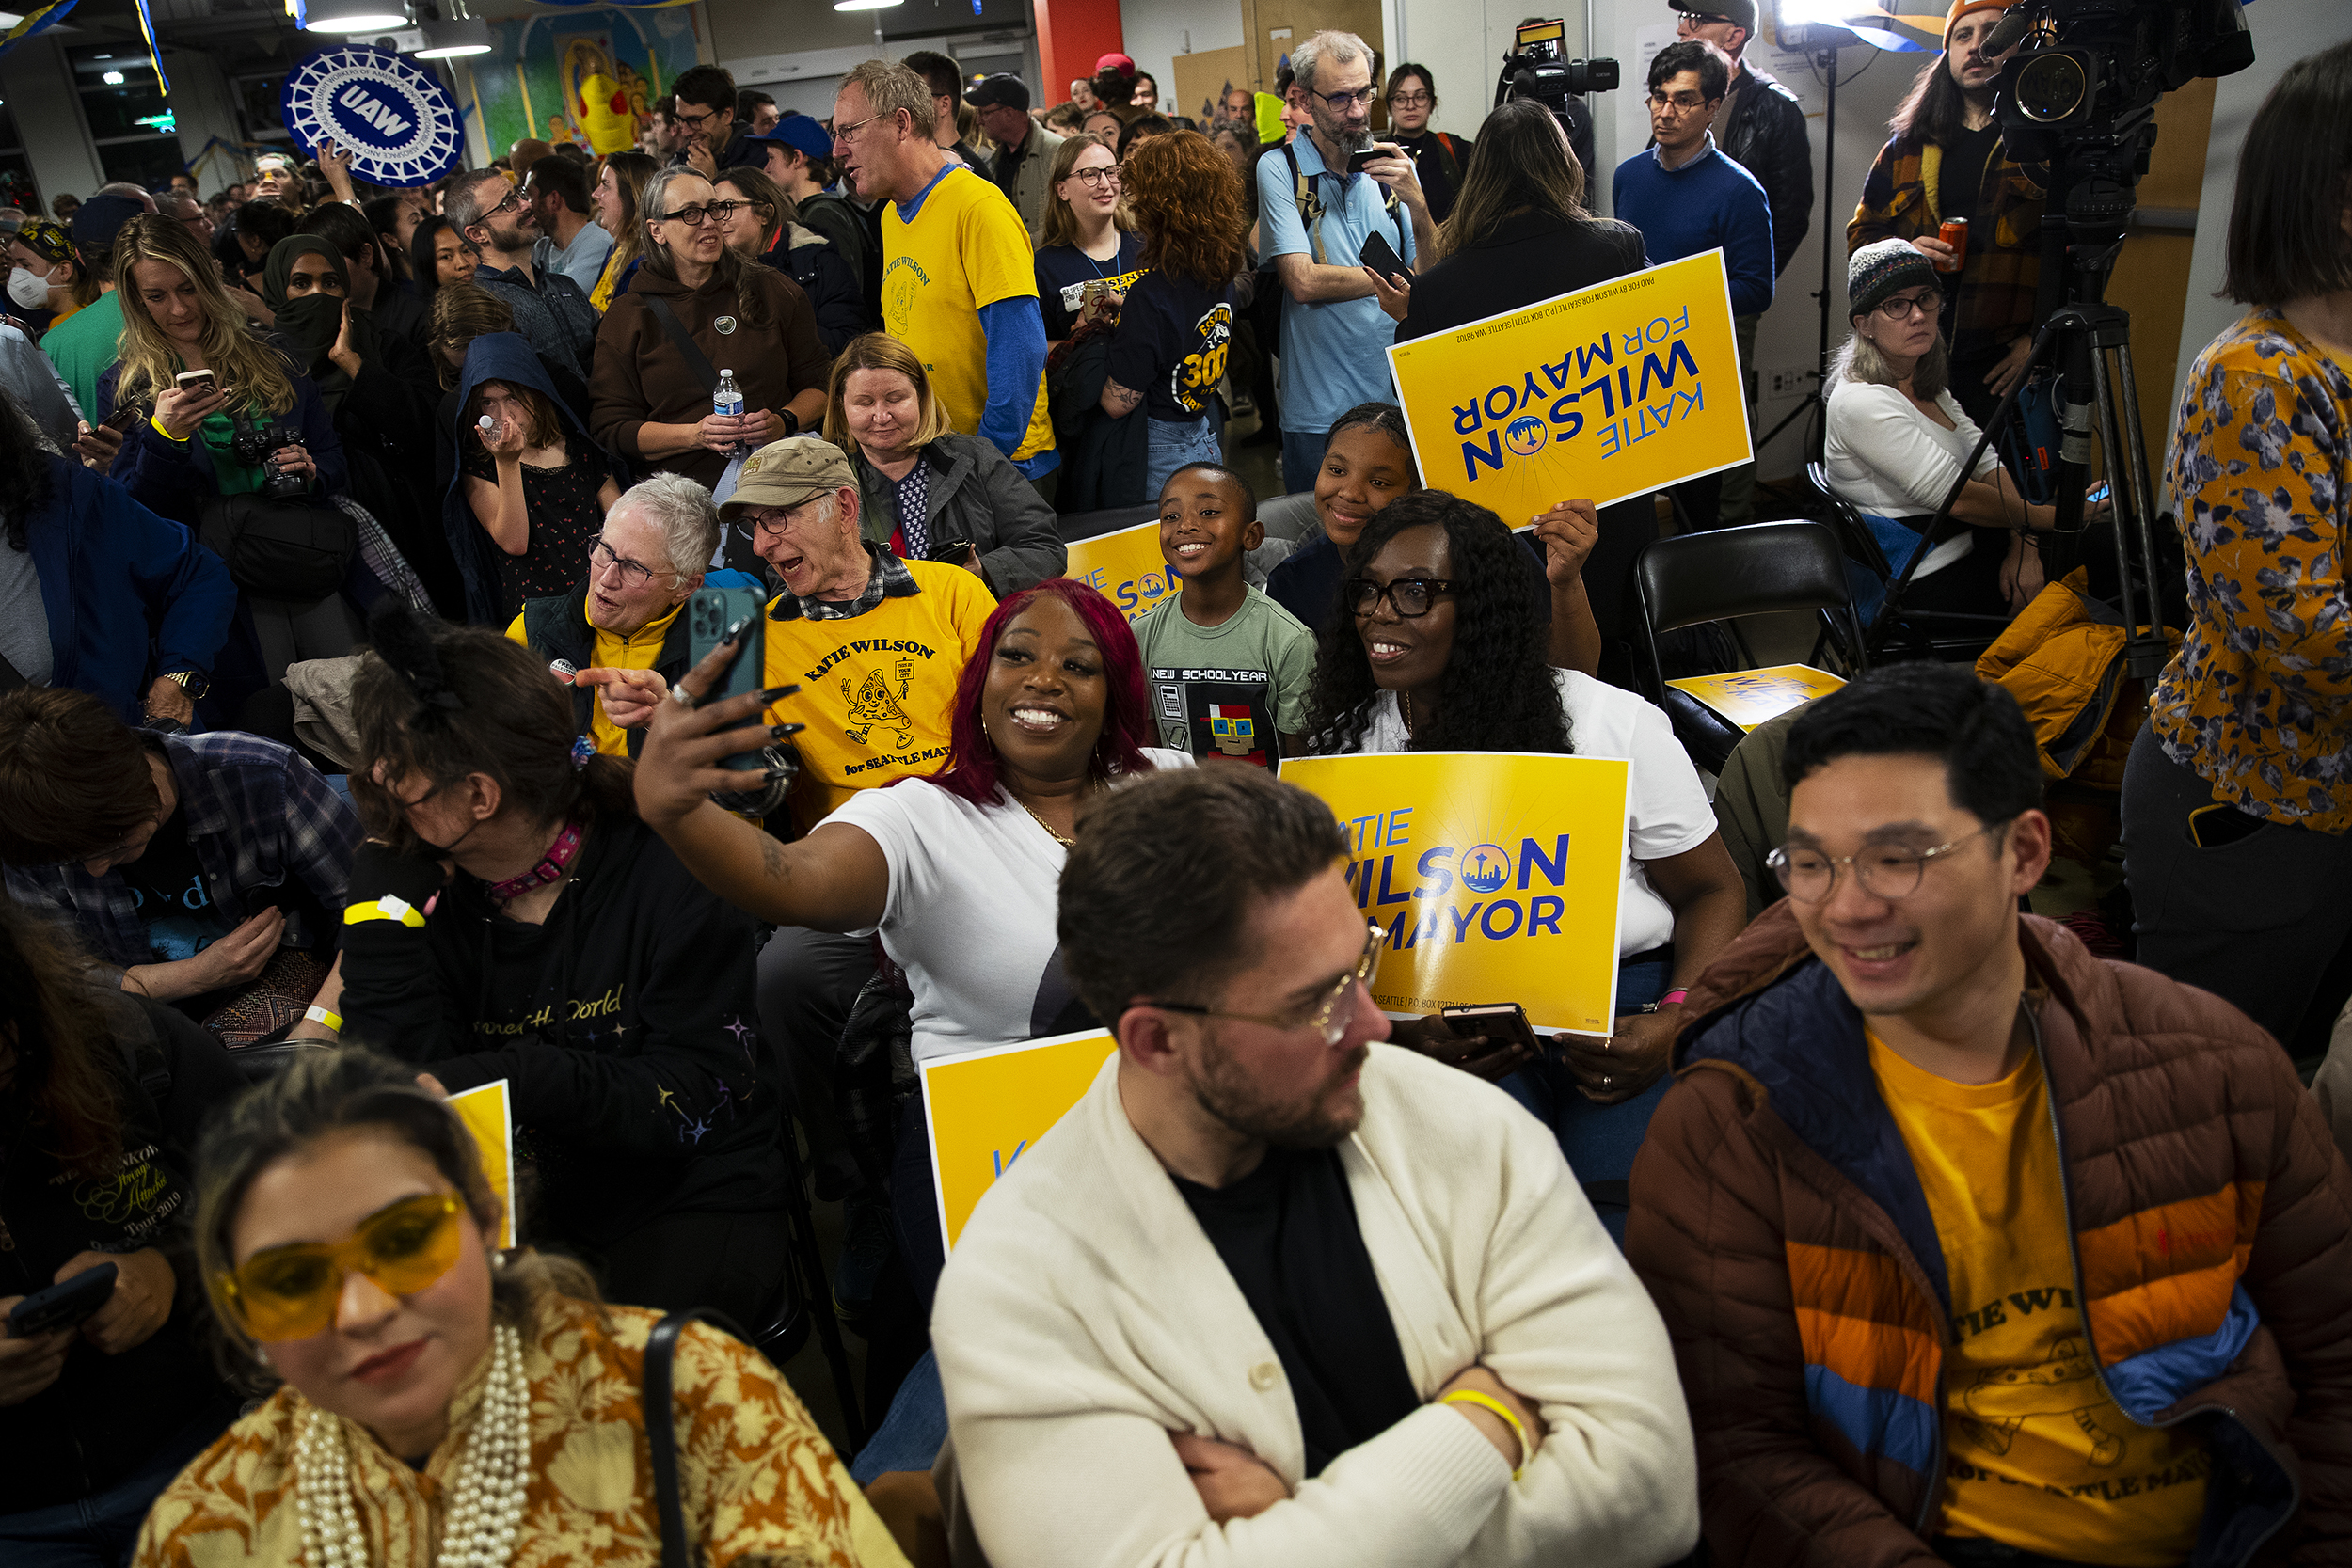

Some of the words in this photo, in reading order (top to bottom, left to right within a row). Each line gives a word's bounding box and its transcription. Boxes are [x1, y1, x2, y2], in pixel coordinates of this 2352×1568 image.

[327, 69, 360, 85] WORKERS
[372, 70, 405, 88] AMERICA
[315, 81, 330, 113] IMPLEMENT
[405, 87, 425, 109] UNITED
[339, 85, 412, 137] UAW
[322, 114, 363, 151] AGRICULTURAL
[363, 149, 381, 157] AND
[901, 256, 930, 287] WILSON
[1062, 284, 1084, 295] RESPEC
[1619, 283, 1629, 293] BY
[1628, 280, 1641, 292] FOR
[1642, 277, 1655, 287] PAID
[1581, 292, 1595, 306] FOR
[1595, 287, 1619, 301] WILSON
[1559, 298, 1582, 313] SEATTLE
[1515, 315, 1531, 326] 12171
[1531, 311, 1544, 322] BOX
[1455, 331, 1475, 343] 98102
[1474, 327, 1486, 338] WA
[1622, 305, 1691, 356] FOR
[1180, 342, 1229, 388] 300
[1451, 331, 1614, 436] MAYOR
[1461, 339, 1700, 483] WILSON
[1597, 381, 1704, 460] KATIE
[557, 659, 574, 670] FREE
[804, 645, 850, 682] KATIE
[850, 639, 936, 659] WILSON
[1152, 669, 1175, 679] NEW
[1724, 676, 1812, 704] WILS
[845, 763, 866, 776] for
[922, 746, 951, 761] MAY
[1378, 995, 1405, 1006] SEATTLE
[1408, 997, 1421, 1008] P.O.
[1422, 999, 1436, 1009] BOX
[123, 1213, 158, 1237] Tour
[157, 1191, 182, 1219] 2019
